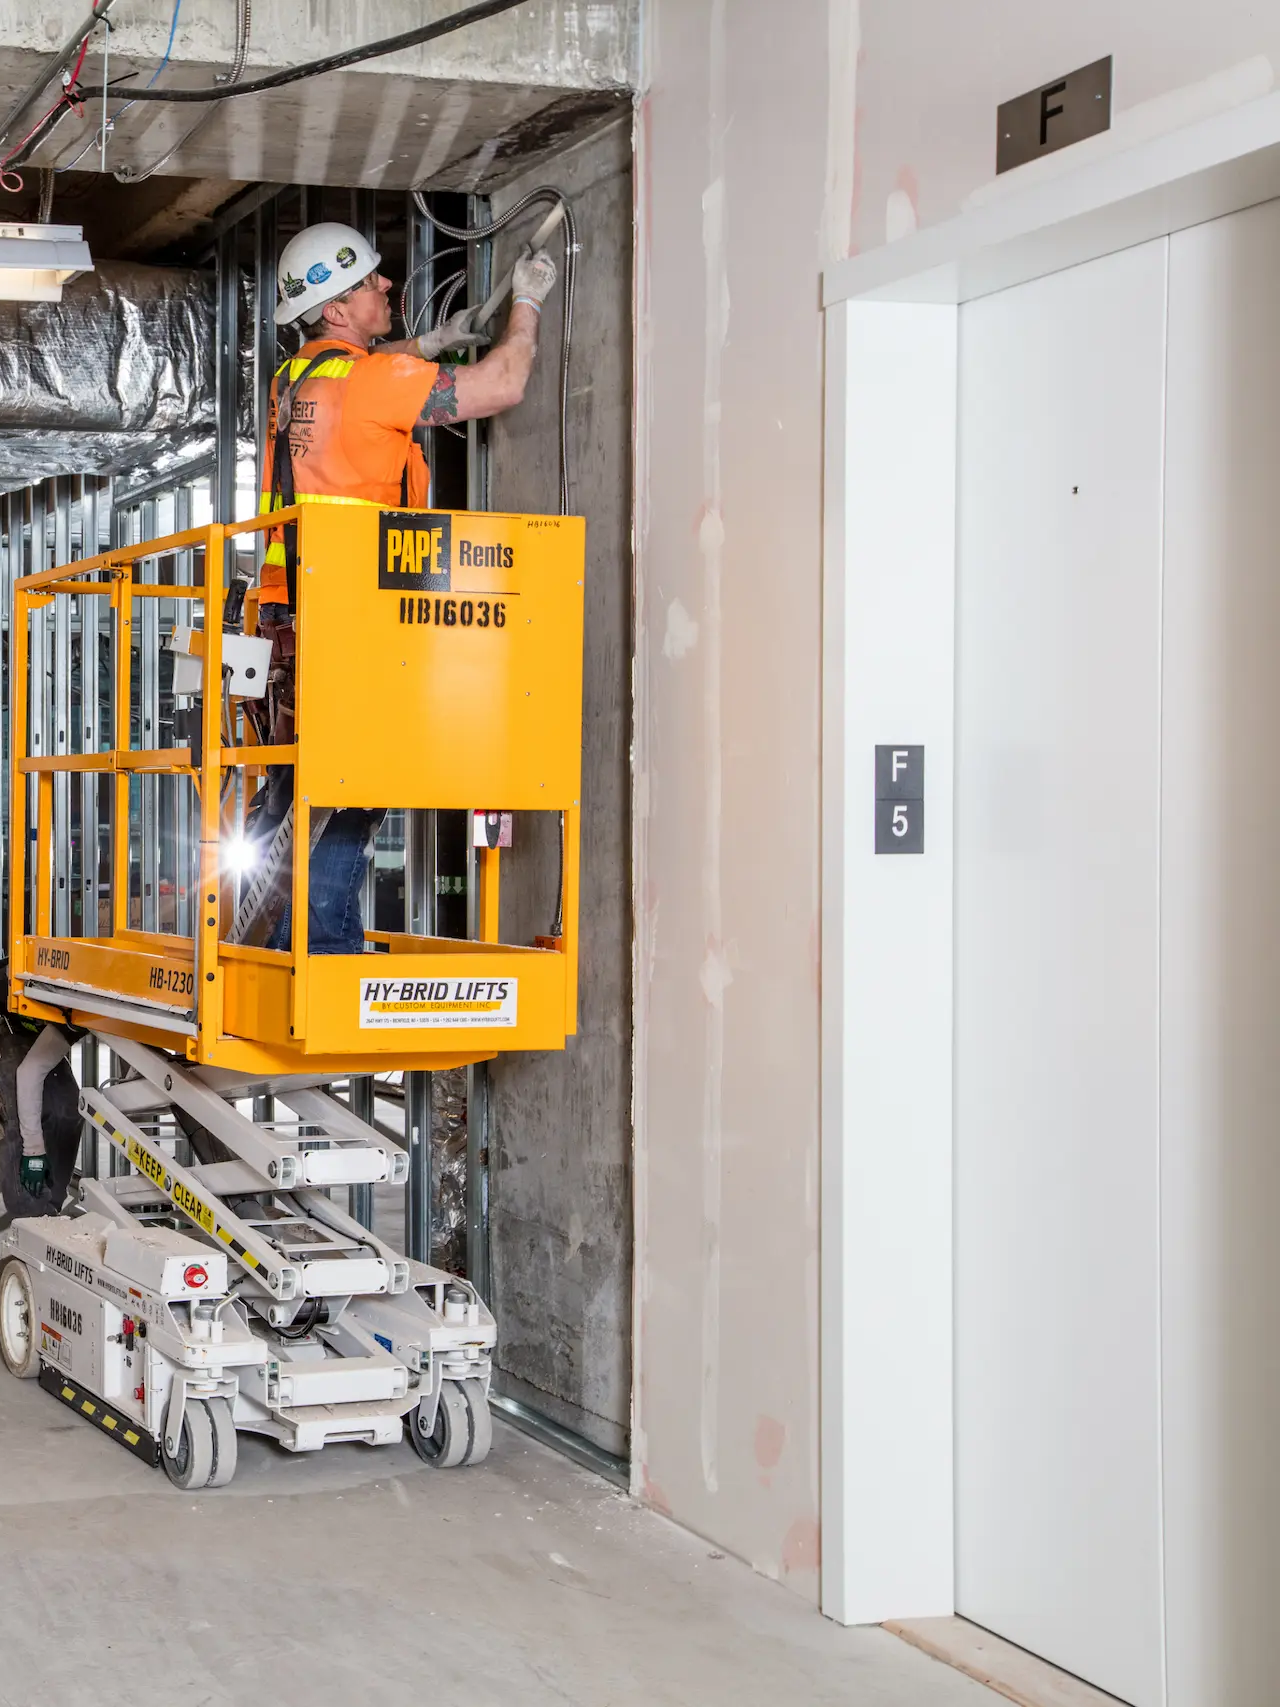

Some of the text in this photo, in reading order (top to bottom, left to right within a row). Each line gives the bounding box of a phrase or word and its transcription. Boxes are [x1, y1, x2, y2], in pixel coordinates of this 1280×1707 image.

[1040, 81, 1066, 145] F
[387, 527, 514, 574] PAPÉ Rents
[399, 597, 507, 628] HB16036
[892, 750, 909, 782] F
[891, 805, 909, 837] 5
[37, 948, 70, 971] HY-BRID
[149, 967, 195, 995] HB-1230
[364, 982, 509, 1001] HY-BRID LIFTS
[381, 1002, 392, 1010] BY
[394, 1002, 426, 1010] CUSTOM
[139, 1147, 162, 1182] KEEP
[173, 1181, 202, 1222] CLEAR
[46, 1245, 73, 1273] HY-BRID
[74, 1260, 94, 1285] LIFTS
[50, 1297, 83, 1336] HB16036
